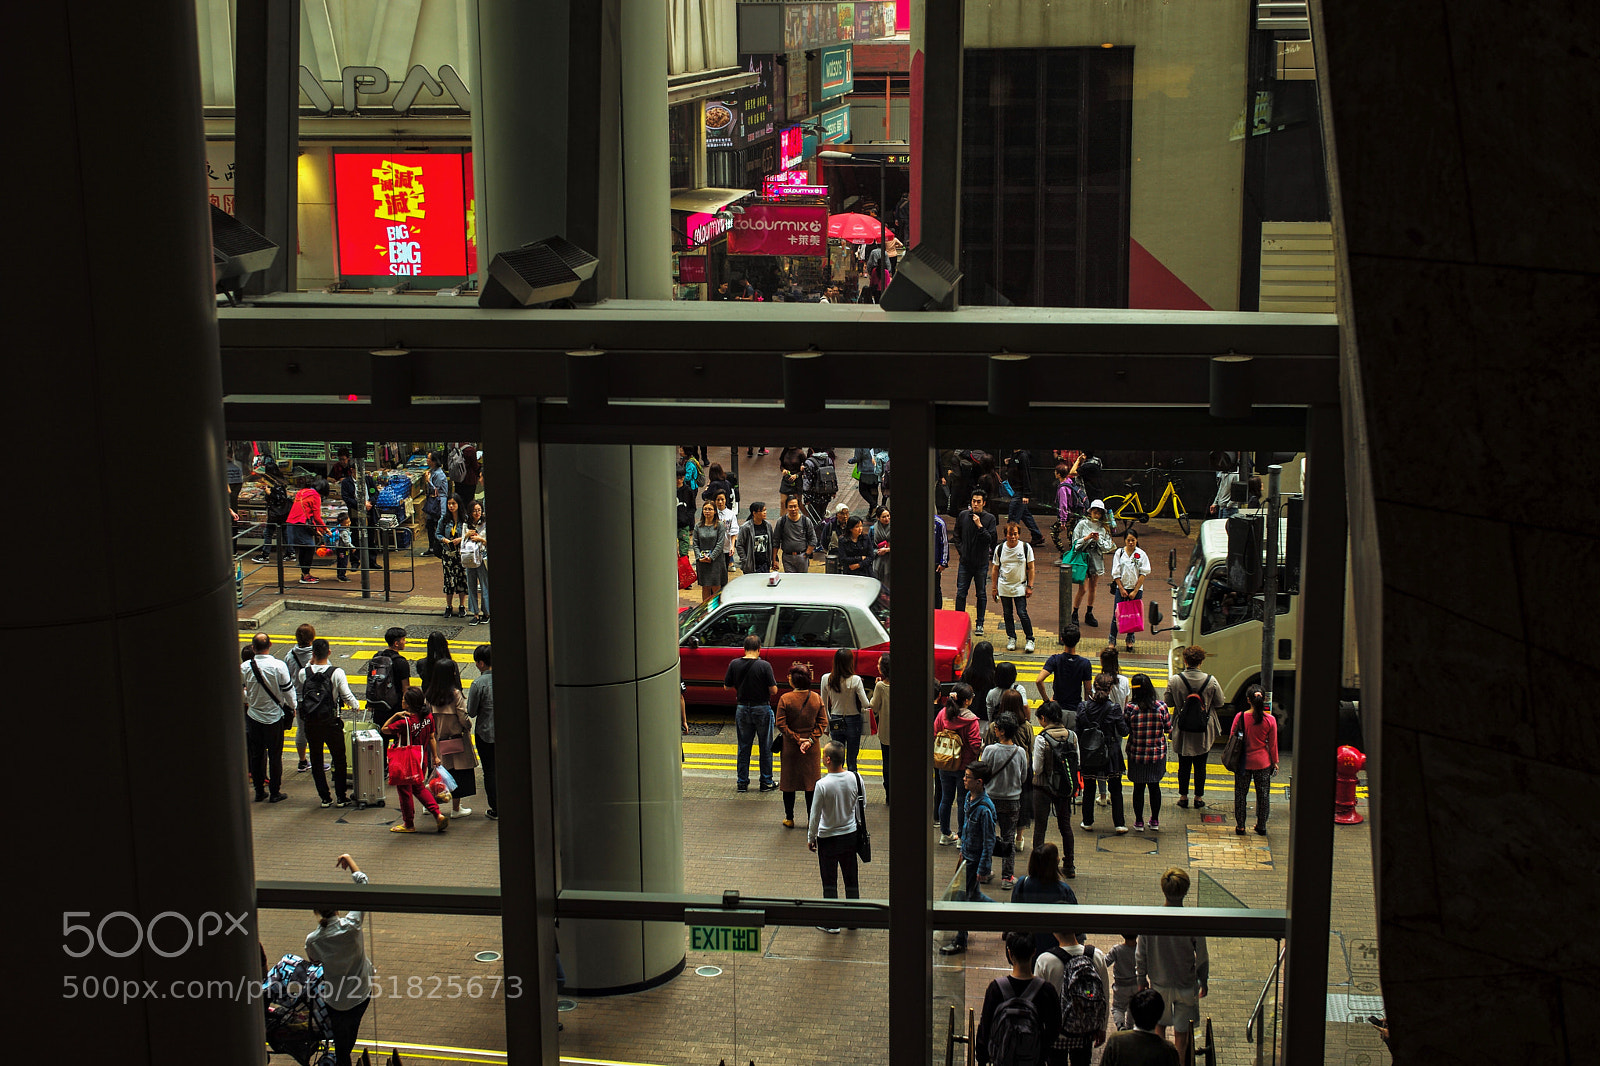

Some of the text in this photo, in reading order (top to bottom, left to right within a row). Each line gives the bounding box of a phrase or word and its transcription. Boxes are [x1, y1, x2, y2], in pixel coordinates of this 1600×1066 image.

[386, 224, 410, 241] BIG
[734, 218, 809, 232] colourmix
[388, 241, 422, 264] BIG
[692, 927, 759, 952] EXIT 出口
